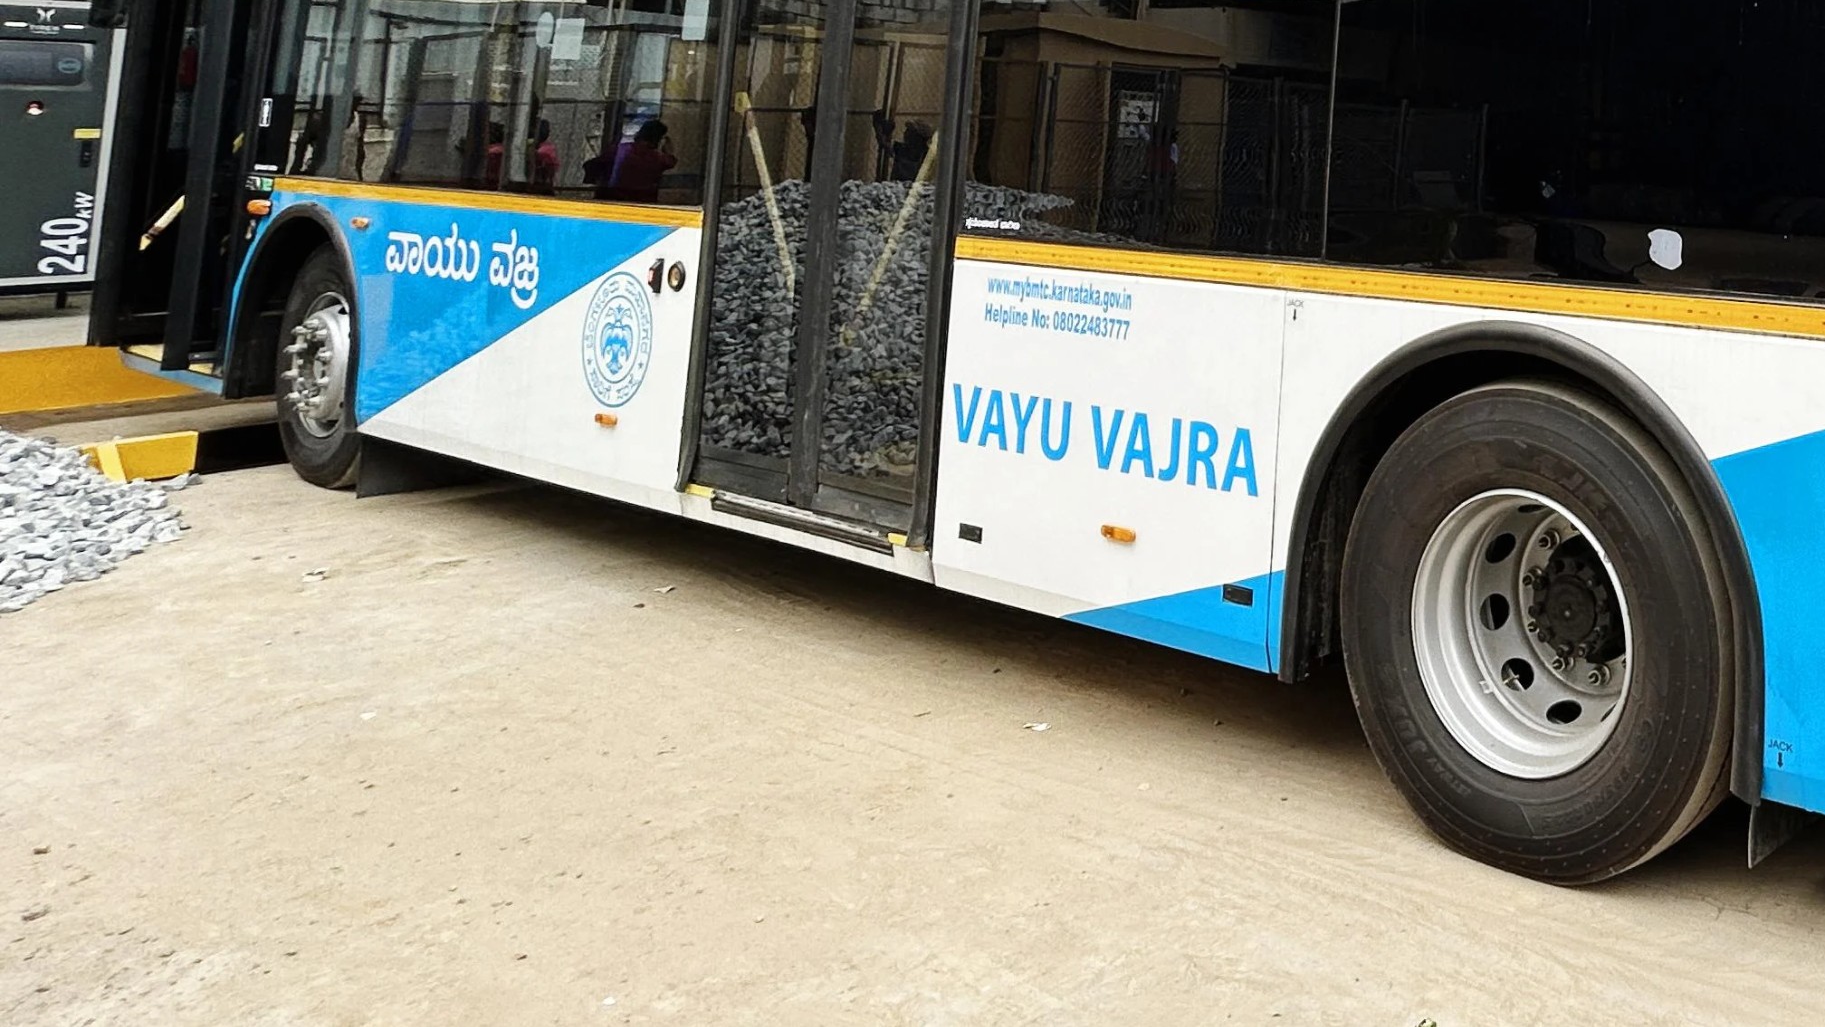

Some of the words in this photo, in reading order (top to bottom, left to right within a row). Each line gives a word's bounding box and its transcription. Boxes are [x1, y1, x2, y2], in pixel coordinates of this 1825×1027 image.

[385, 222, 481, 282] ವಾಯು
[489, 228, 540, 310] ವಜ್ರ
[988, 277, 1132, 312] www.mybmtc.karnataka.gov.in
[985, 303, 1028, 328] Helpline
[1032, 309, 1050, 329] No:
[1053, 311, 1131, 340] 08022483777
[953, 383, 1072, 461] VAYU
[1091, 405, 1258, 497] VAJRA
[1768, 739, 1793, 753] JACK
